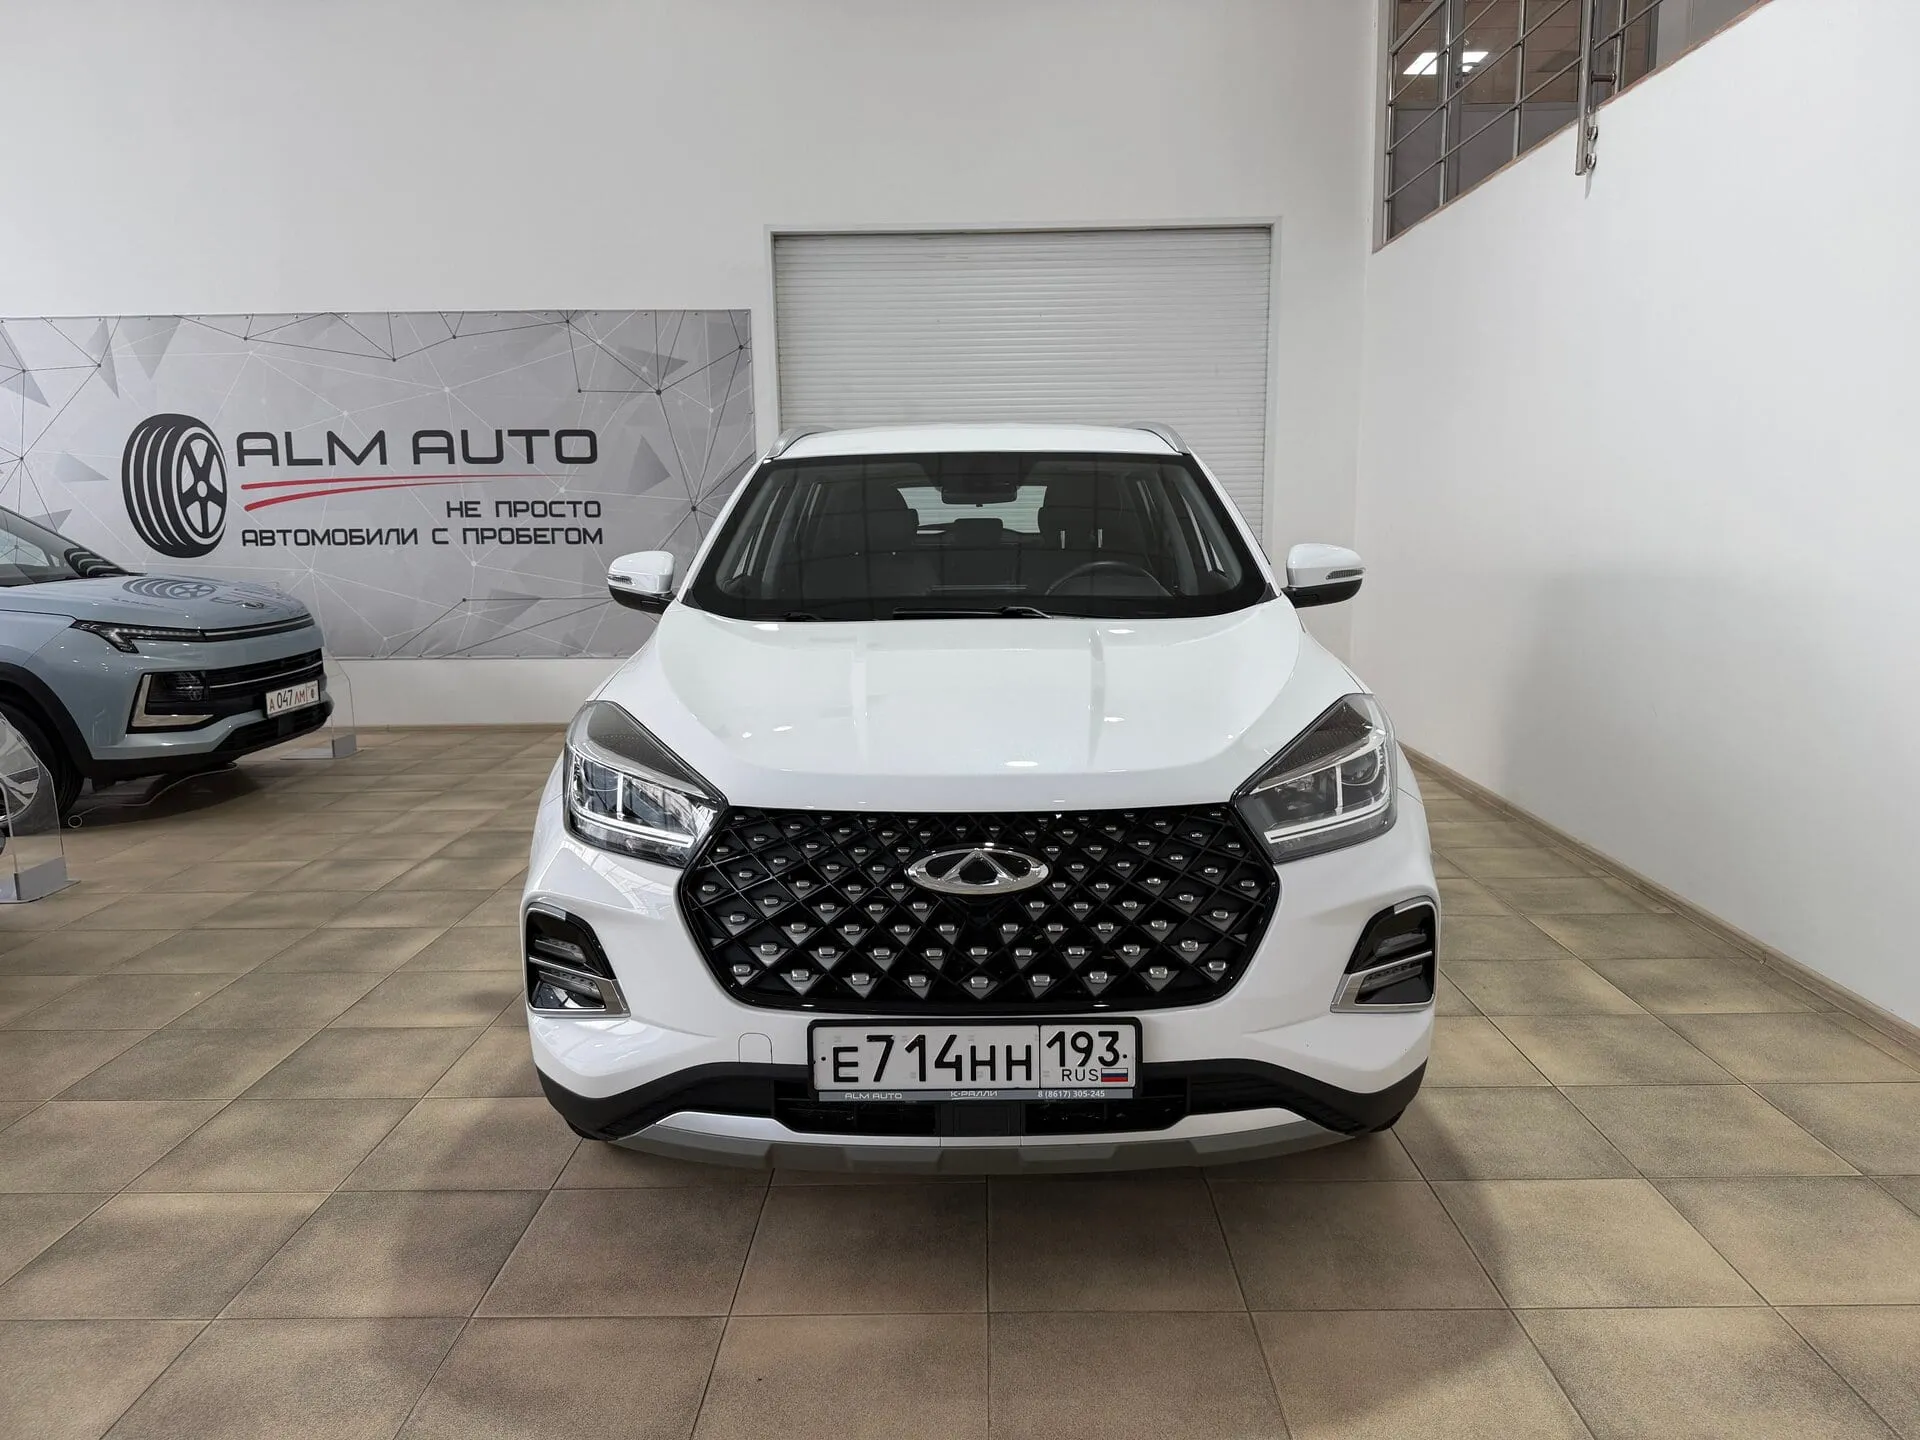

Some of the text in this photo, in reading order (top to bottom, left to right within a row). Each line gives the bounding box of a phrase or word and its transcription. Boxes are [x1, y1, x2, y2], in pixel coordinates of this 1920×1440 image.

[236, 429, 599, 467] ALM AUTO
[446, 501, 602, 518] НЕ ПРОСТО
[241, 527, 603, 546] АВТОМОБИЛИ С ПРОБЕГОМ
[1046, 1031, 1120, 1067] 193
[1061, 1069, 1099, 1082] RUS
[844, 1092, 903, 1100] ALM AUTO
[1044, 1089, 1071, 1099] (8617)
[1072, 1089, 1106, 1098] 305-245
